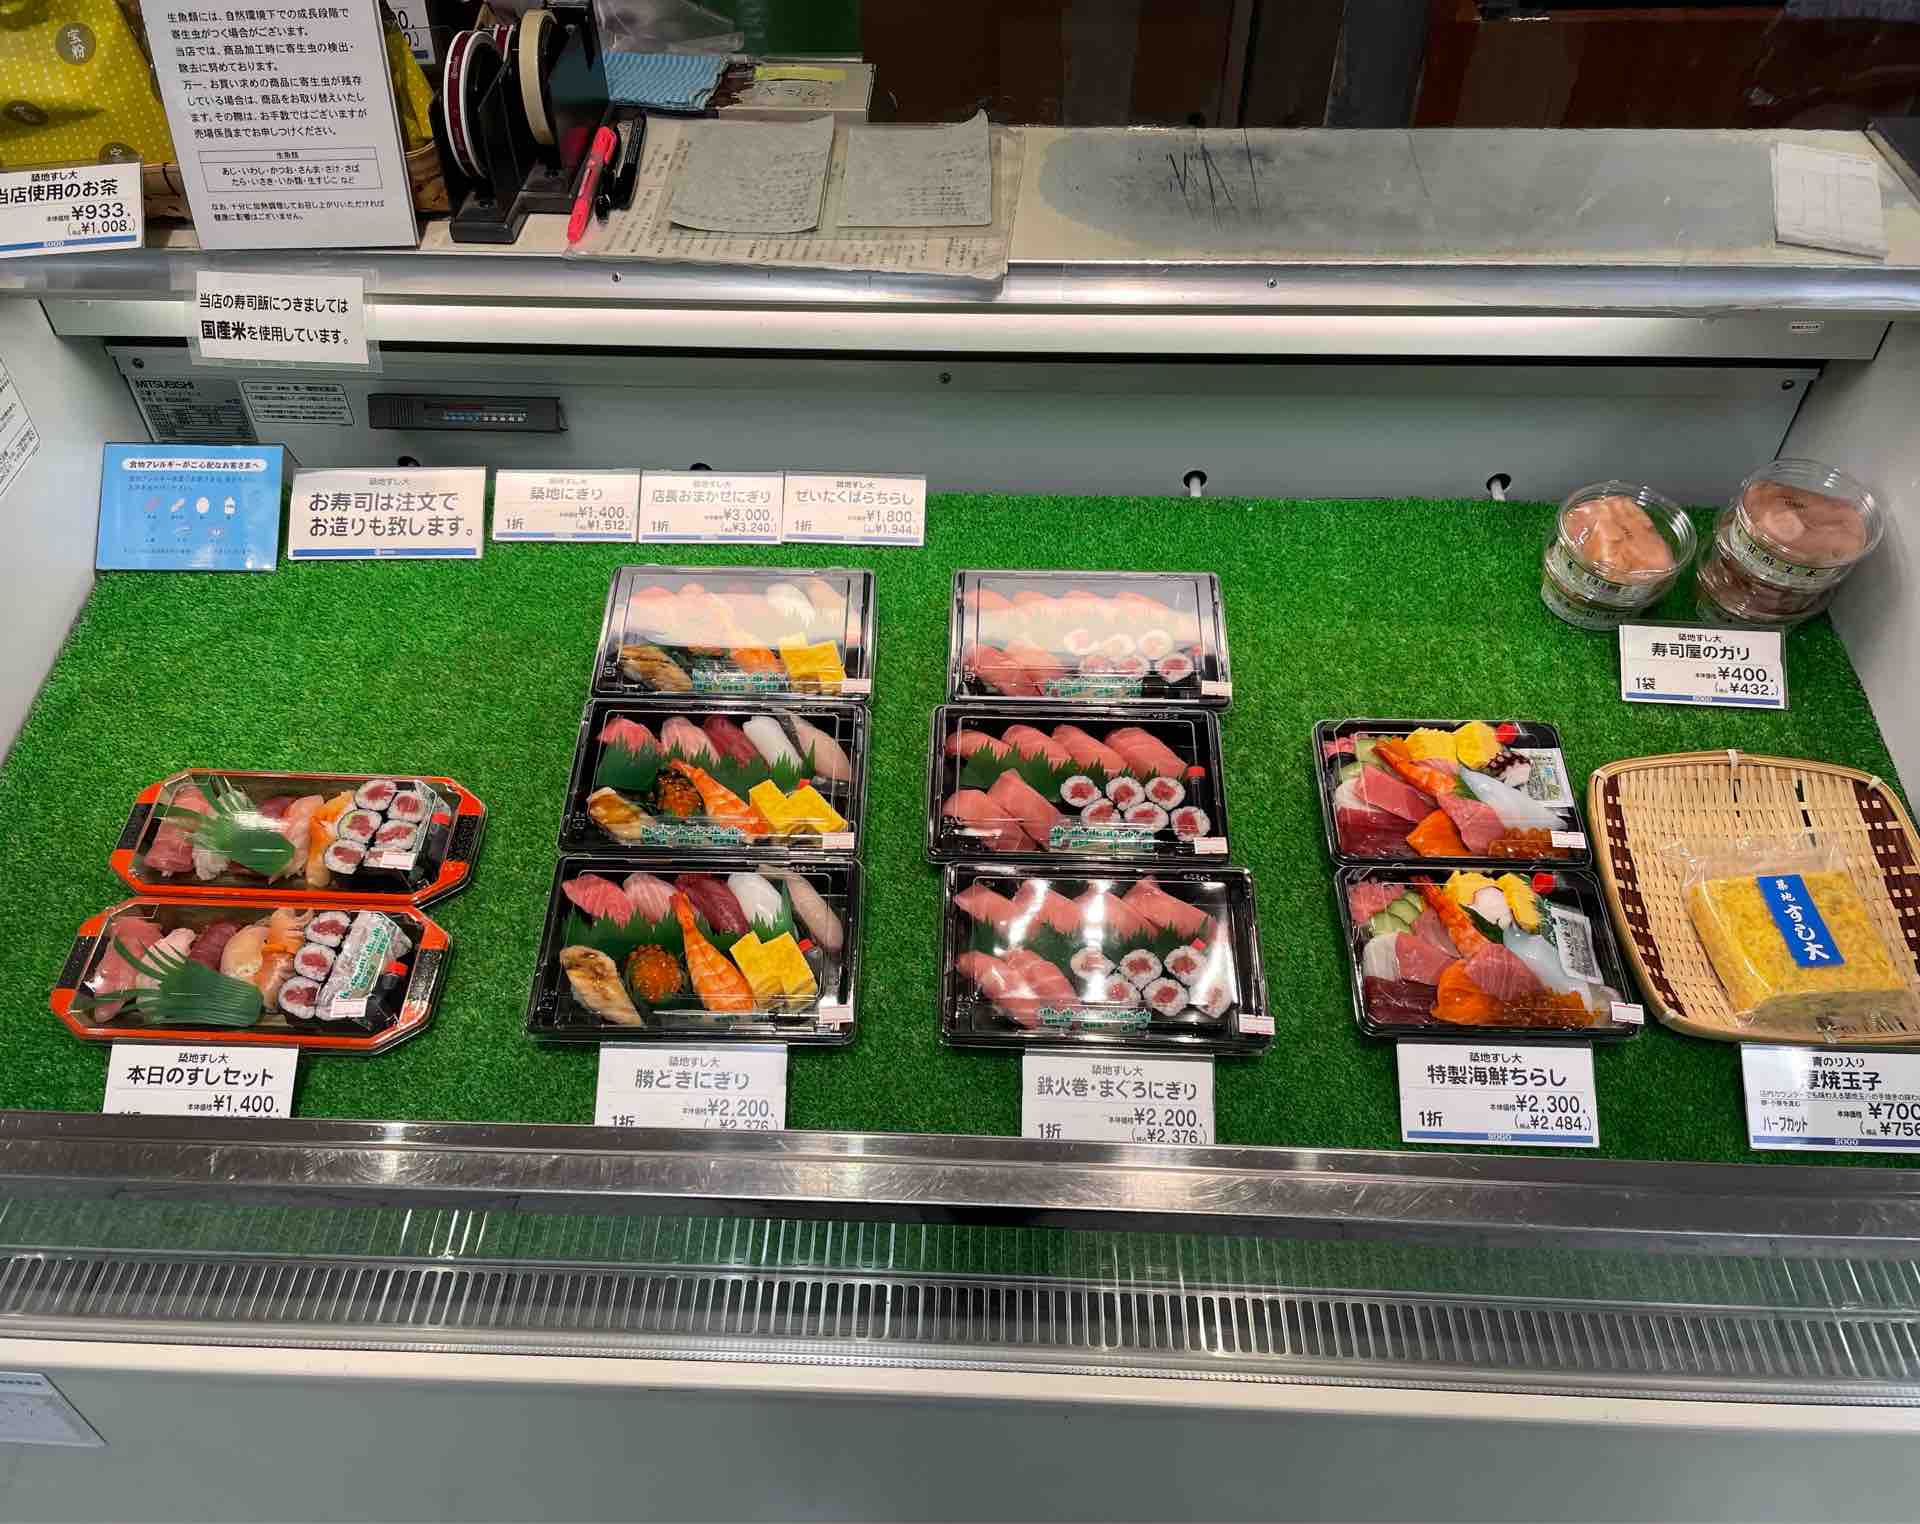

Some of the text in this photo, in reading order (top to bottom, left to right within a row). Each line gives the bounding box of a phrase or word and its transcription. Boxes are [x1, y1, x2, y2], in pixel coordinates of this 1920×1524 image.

[171, 26, 308, 40] 寄生虫がつく場合がございます。
[0, 179, 118, 204] 当店使用のお茶
[200, 294, 349, 313] 当店の寿司飯につきましては
[201, 320, 350, 345] 国産米を使用しています。
[308, 492, 459, 512] お寿司は注文で
[529, 487, 603, 500] 築地にぎり
[652, 489, 771, 503] 店長おまかせにぎり
[795, 488, 914, 505] ぜいたくばらちらし
[309, 516, 473, 537] お造りも致します。
[1651, 643, 1750, 660] 寿司屋のガリ
[1635, 677, 1656, 690] 1袋
[178, 1052, 229, 1064] 築地すし大
[1469, 1052, 1522, 1064] 築地すし大
[127, 1065, 273, 1087] 本日のすしセット
[634, 1069, 750, 1090] 勝どきにぎり
[1426, 1064, 1567, 1087] 特製海鮮ちらし
[1037, 1075, 1198, 1101] 鉄火巻・まぐろにぎり
[1418, 1111, 1443, 1128] 1折
